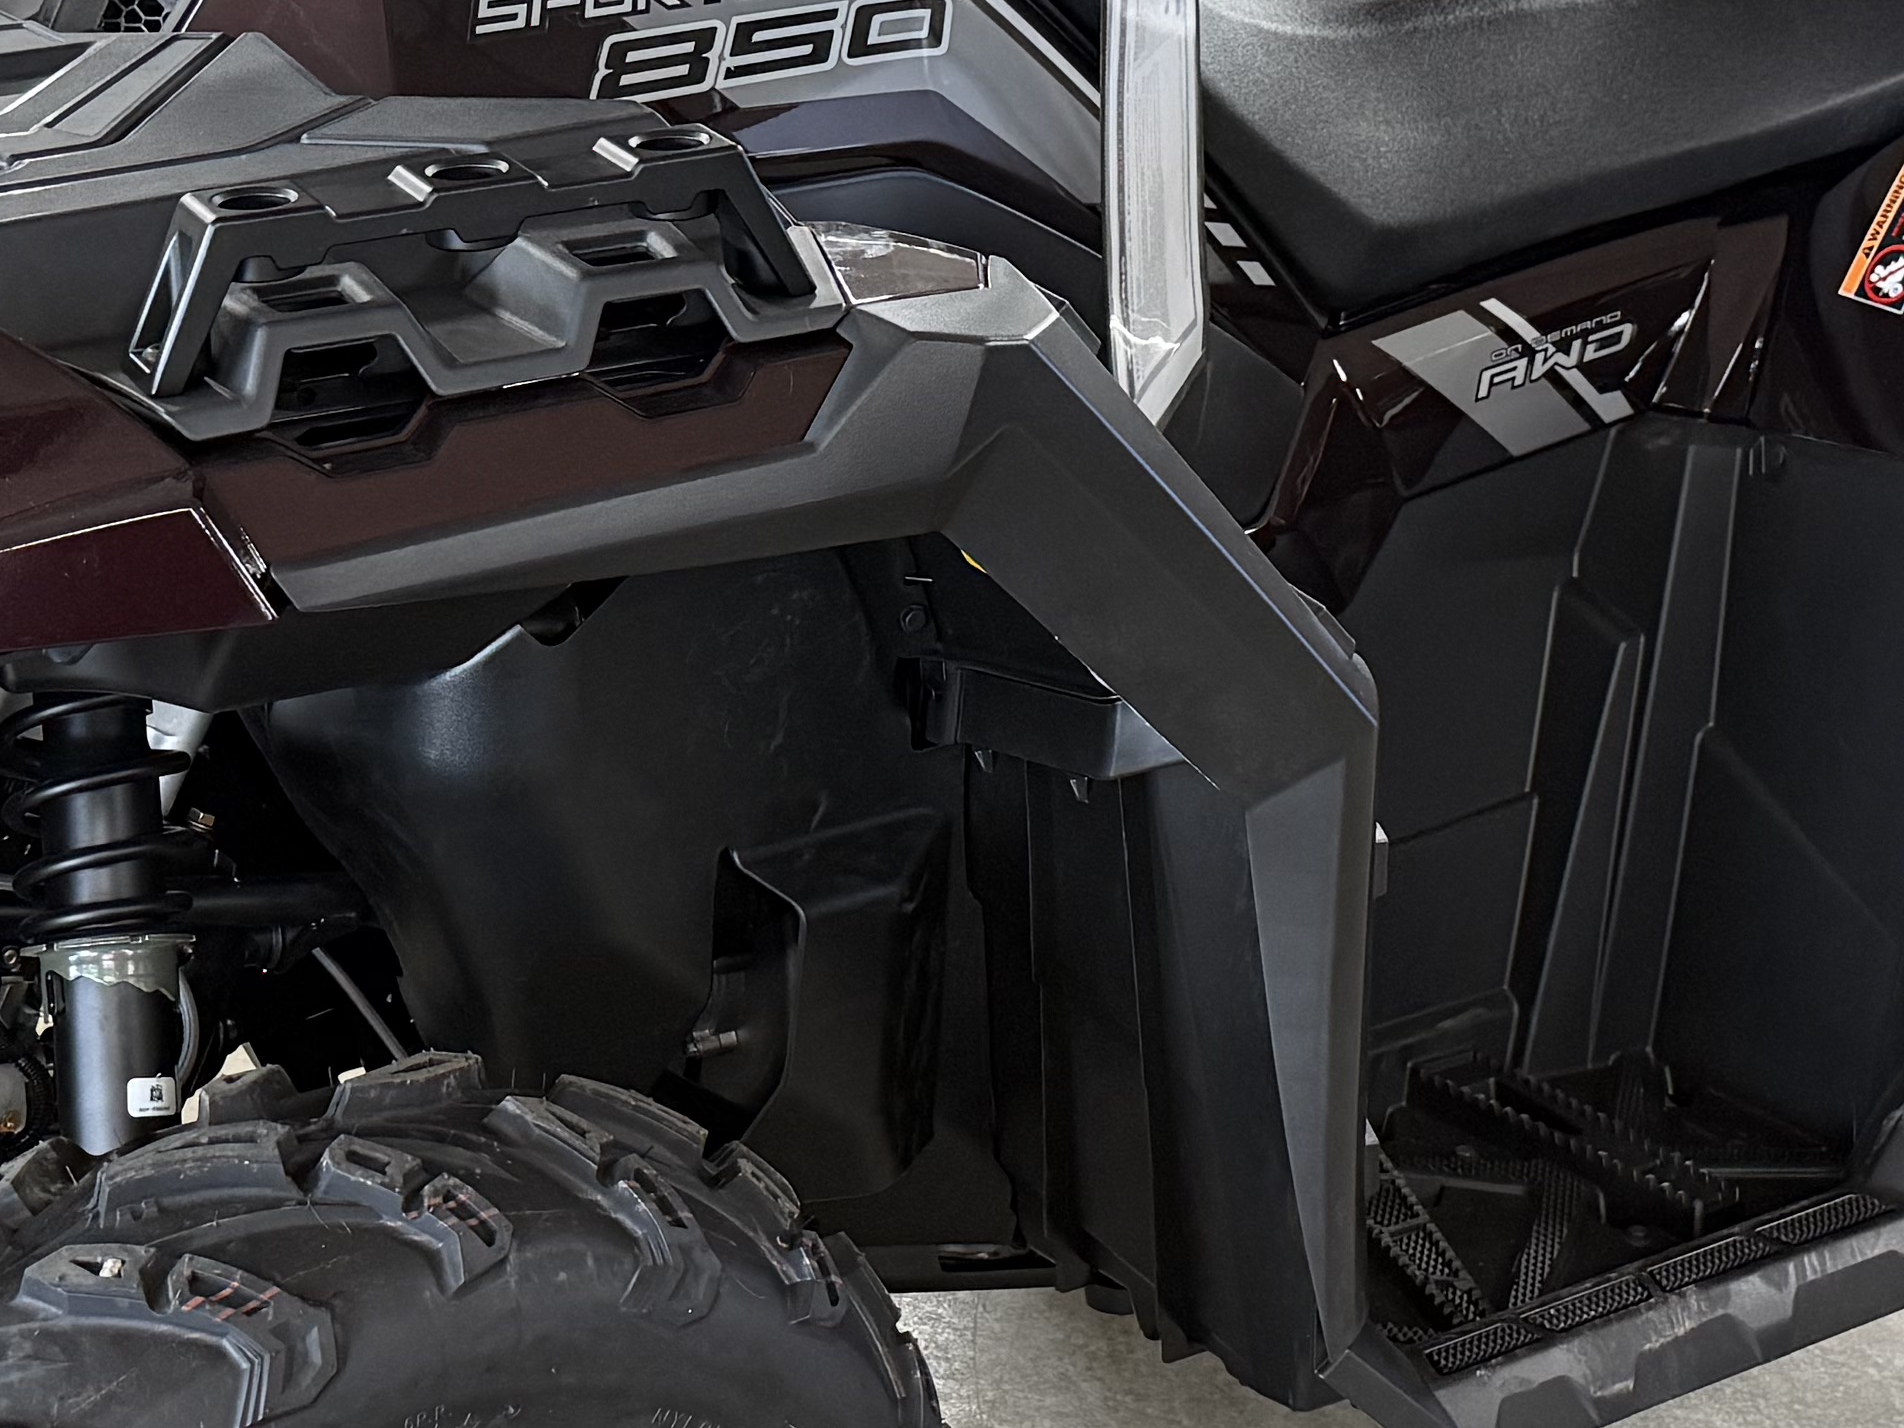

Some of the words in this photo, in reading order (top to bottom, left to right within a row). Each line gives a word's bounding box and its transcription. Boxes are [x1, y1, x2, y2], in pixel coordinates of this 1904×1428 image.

[1476, 322, 1635, 402] AWD
[1490, 343, 1523, 362] ON
[1530, 310, 1622, 349] DEMAND
